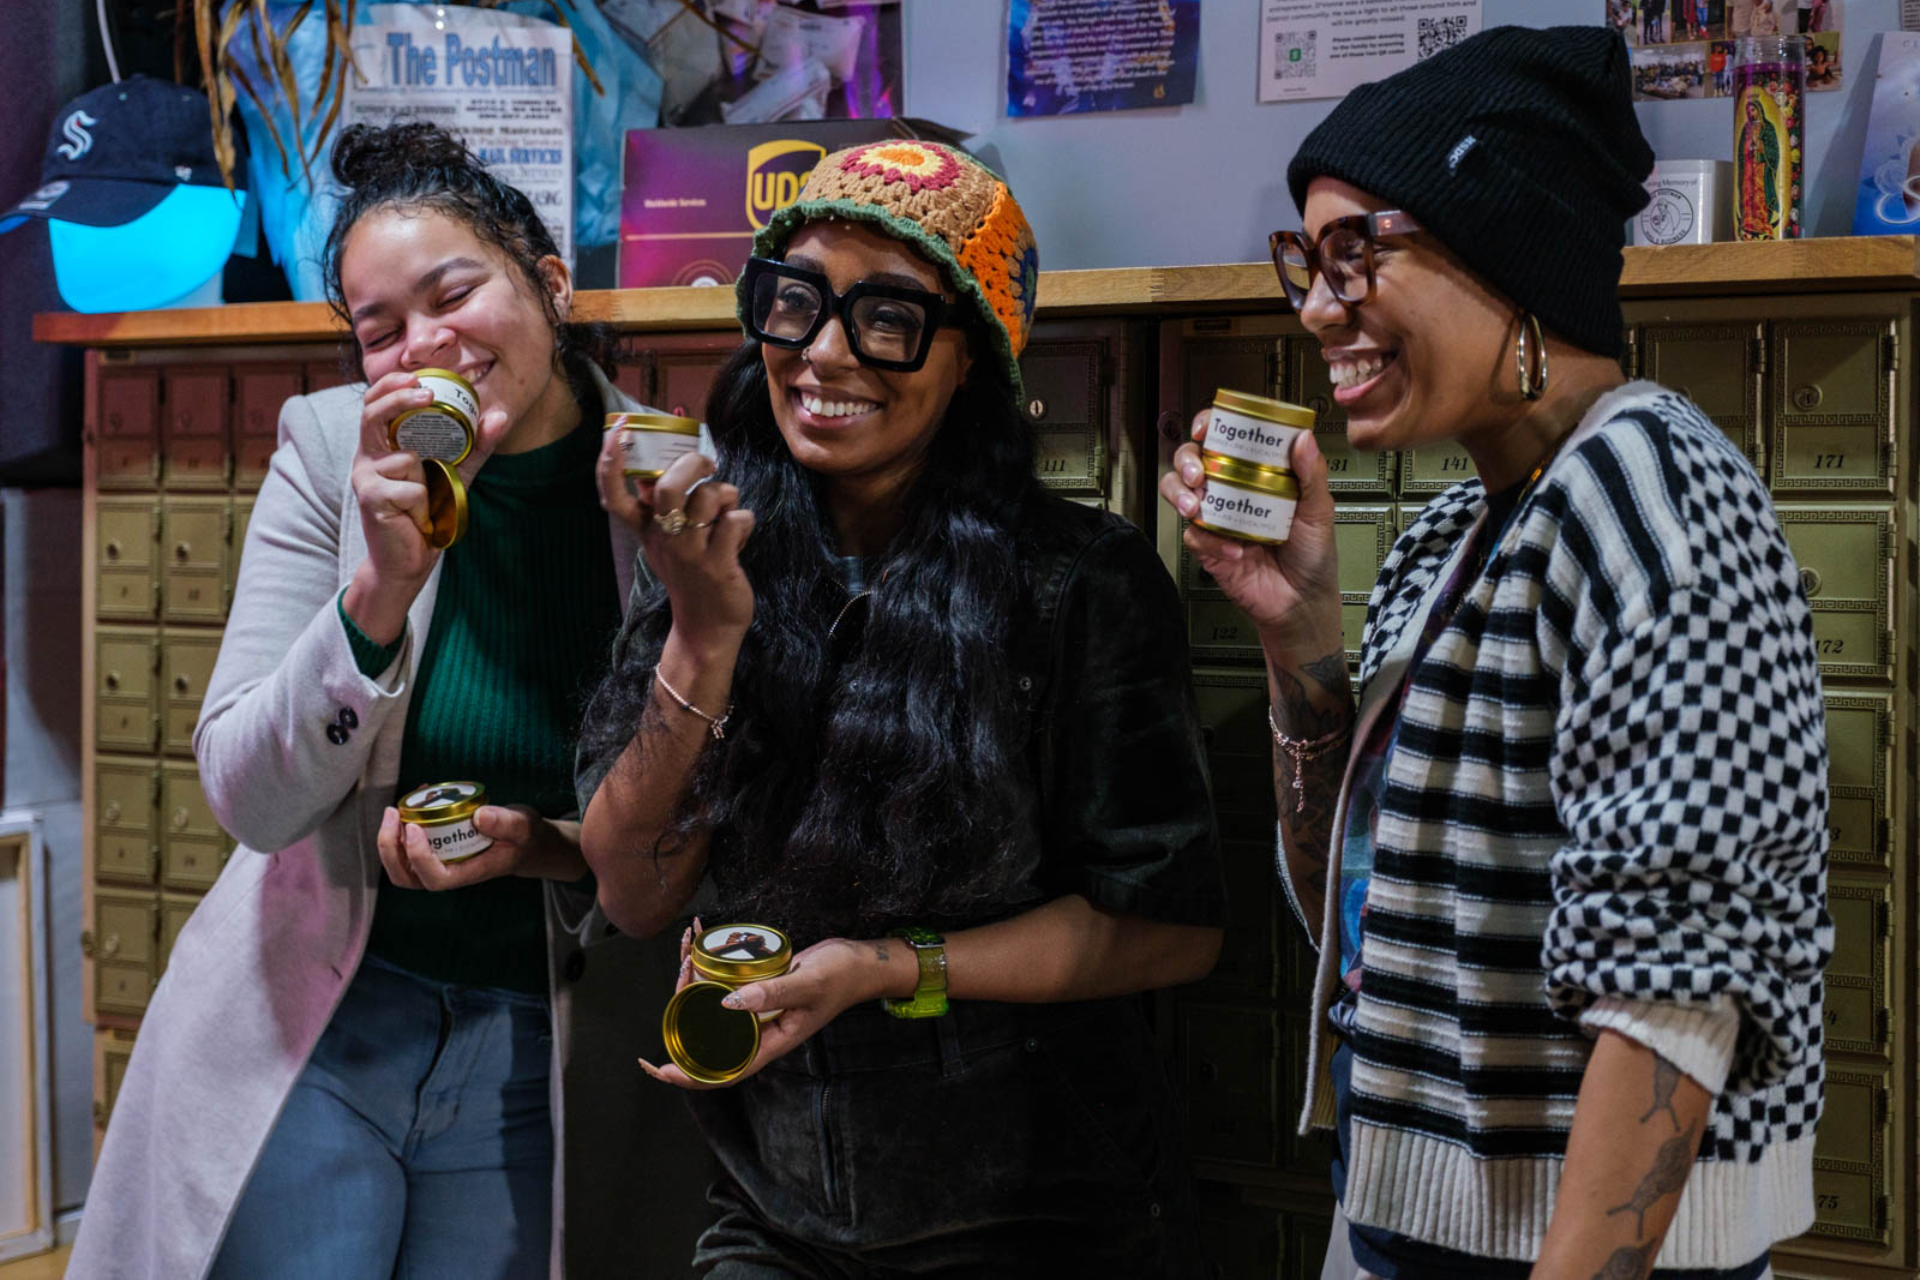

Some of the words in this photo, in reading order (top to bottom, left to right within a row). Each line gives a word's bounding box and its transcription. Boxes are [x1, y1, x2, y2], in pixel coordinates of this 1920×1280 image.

[387, 33, 437, 86] The
[445, 32, 557, 86] Postman
[1214, 418, 1283, 447] Together
[1441, 456, 1468, 470] 141
[1814, 454, 1844, 469] 171
[1201, 488, 1272, 518] Together
[1815, 640, 1844, 654] 172
[1818, 1194, 1839, 1209] 75
